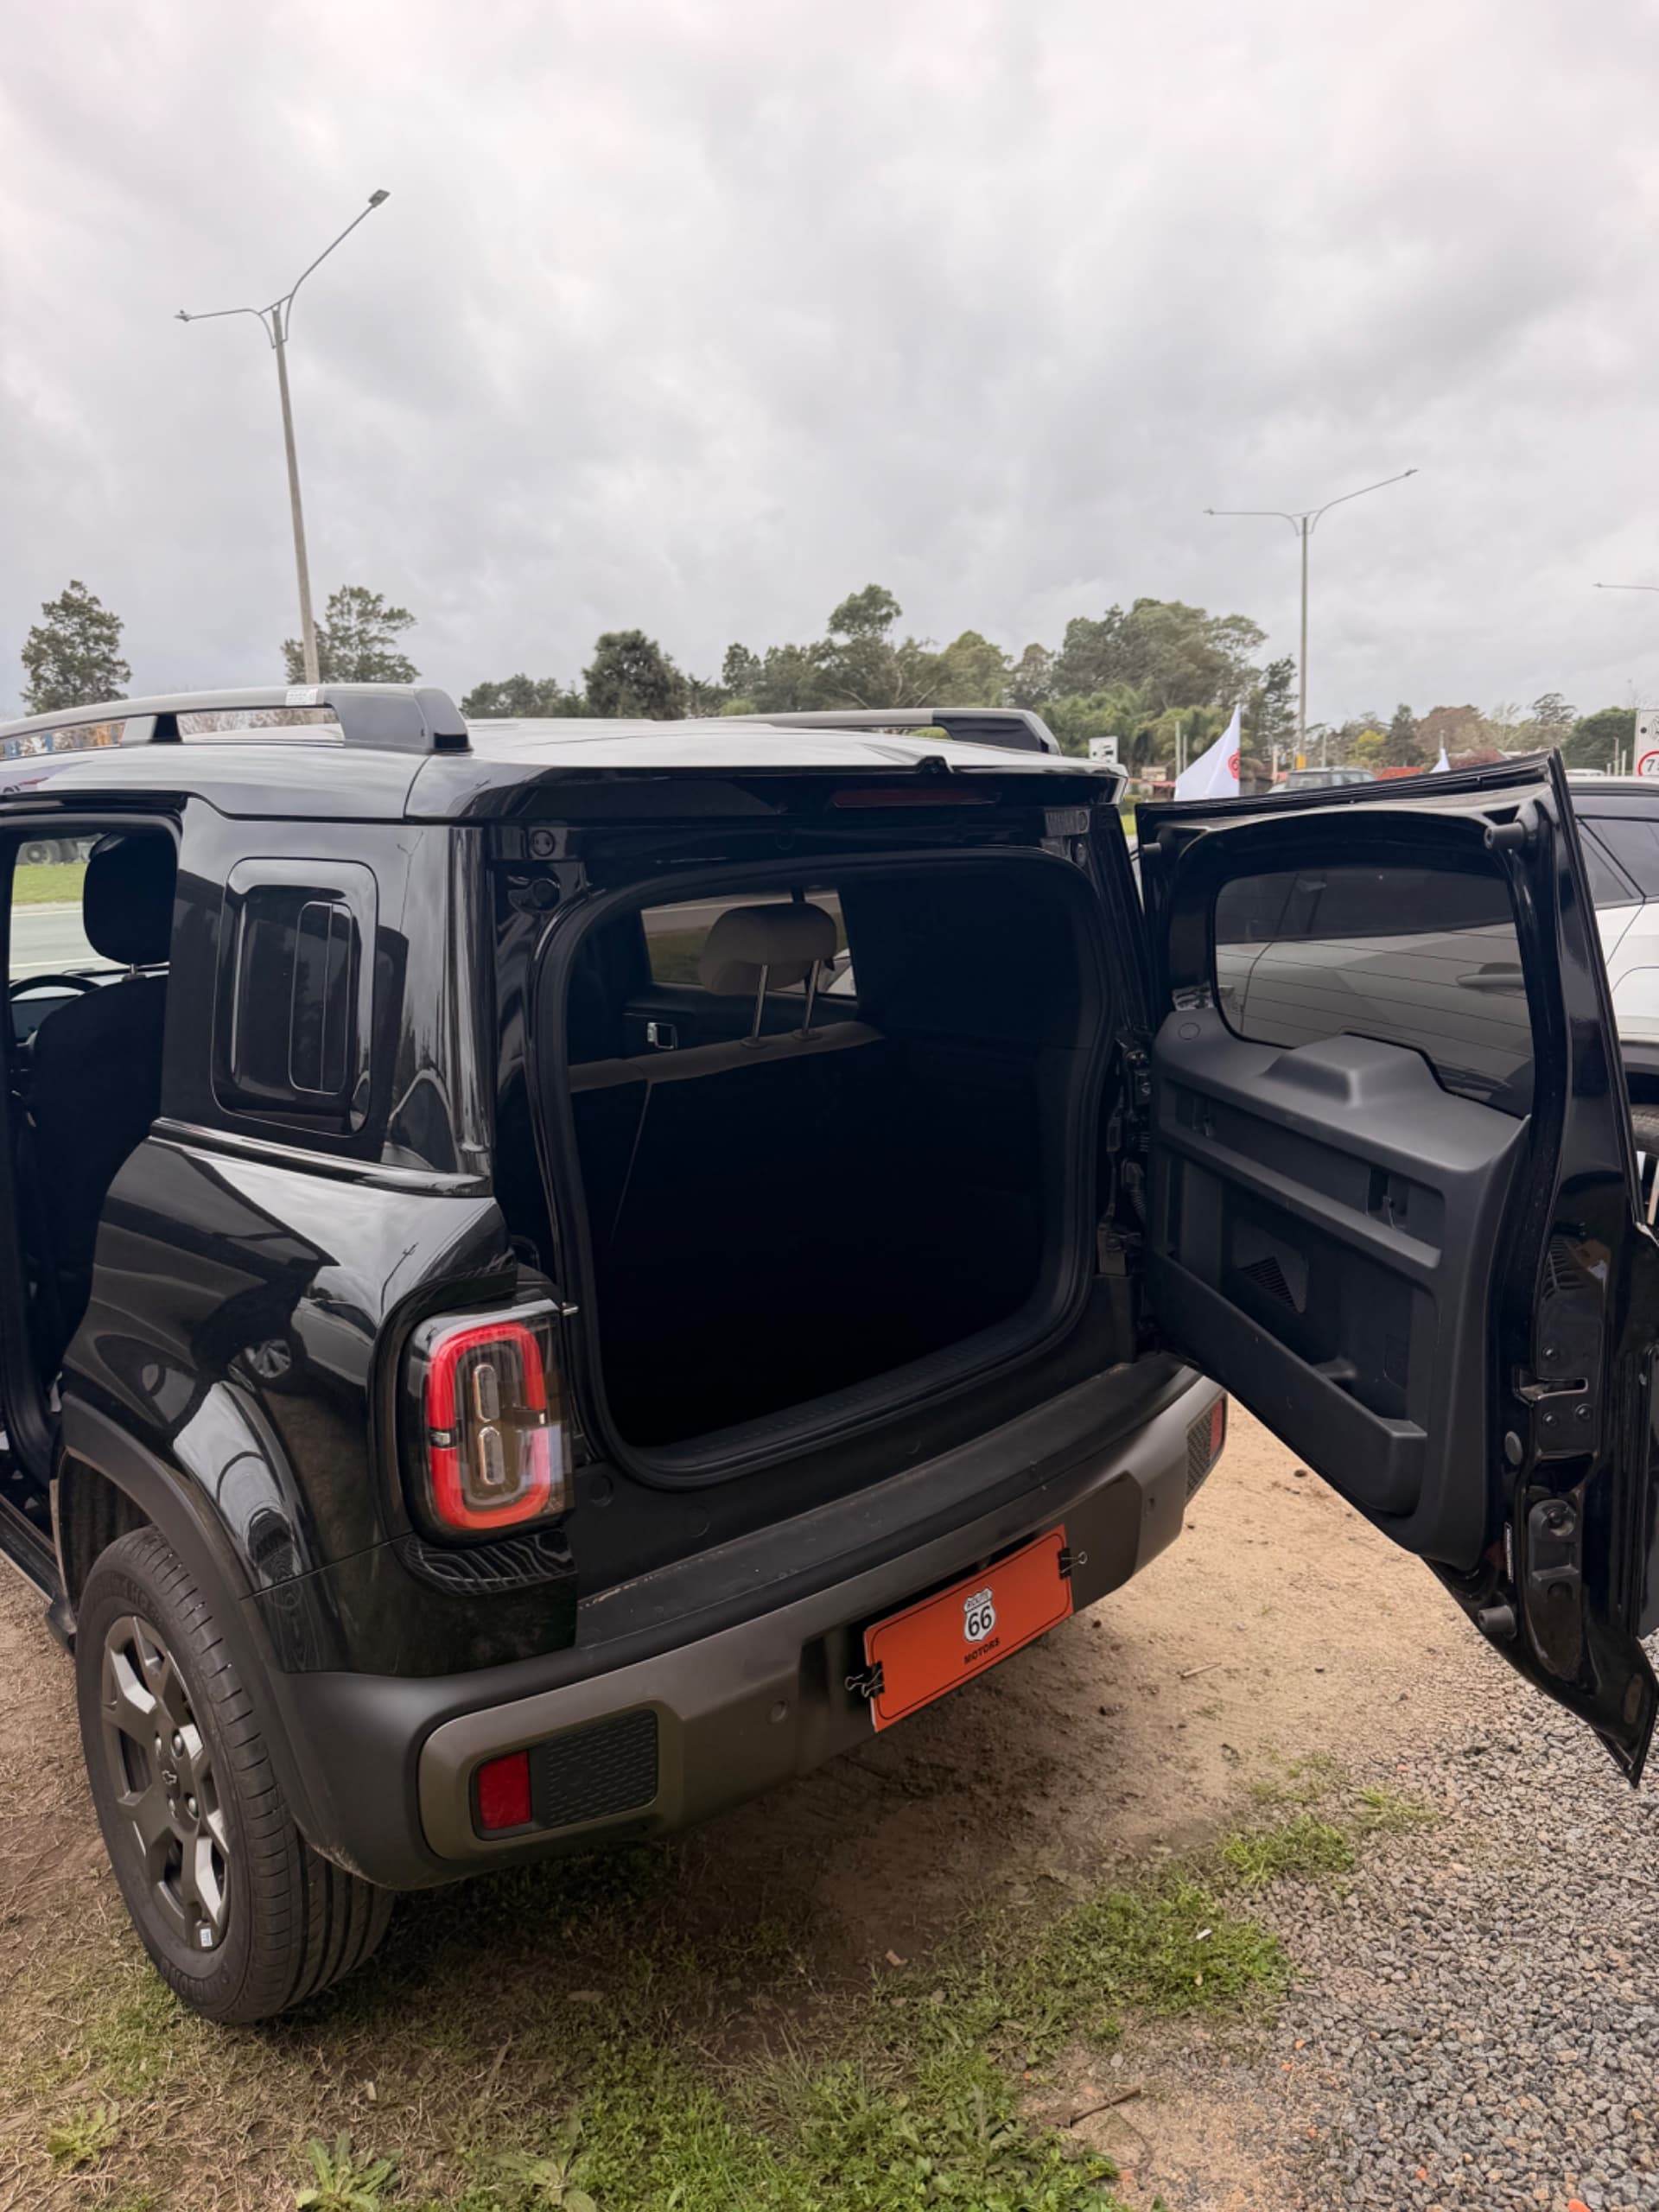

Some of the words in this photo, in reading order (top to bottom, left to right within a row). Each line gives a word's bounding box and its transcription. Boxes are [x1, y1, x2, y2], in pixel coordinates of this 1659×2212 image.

[1646, 759, 1659, 772] 7
[969, 1605, 992, 1637] 66
[964, 1637, 999, 1663] MOTORS
